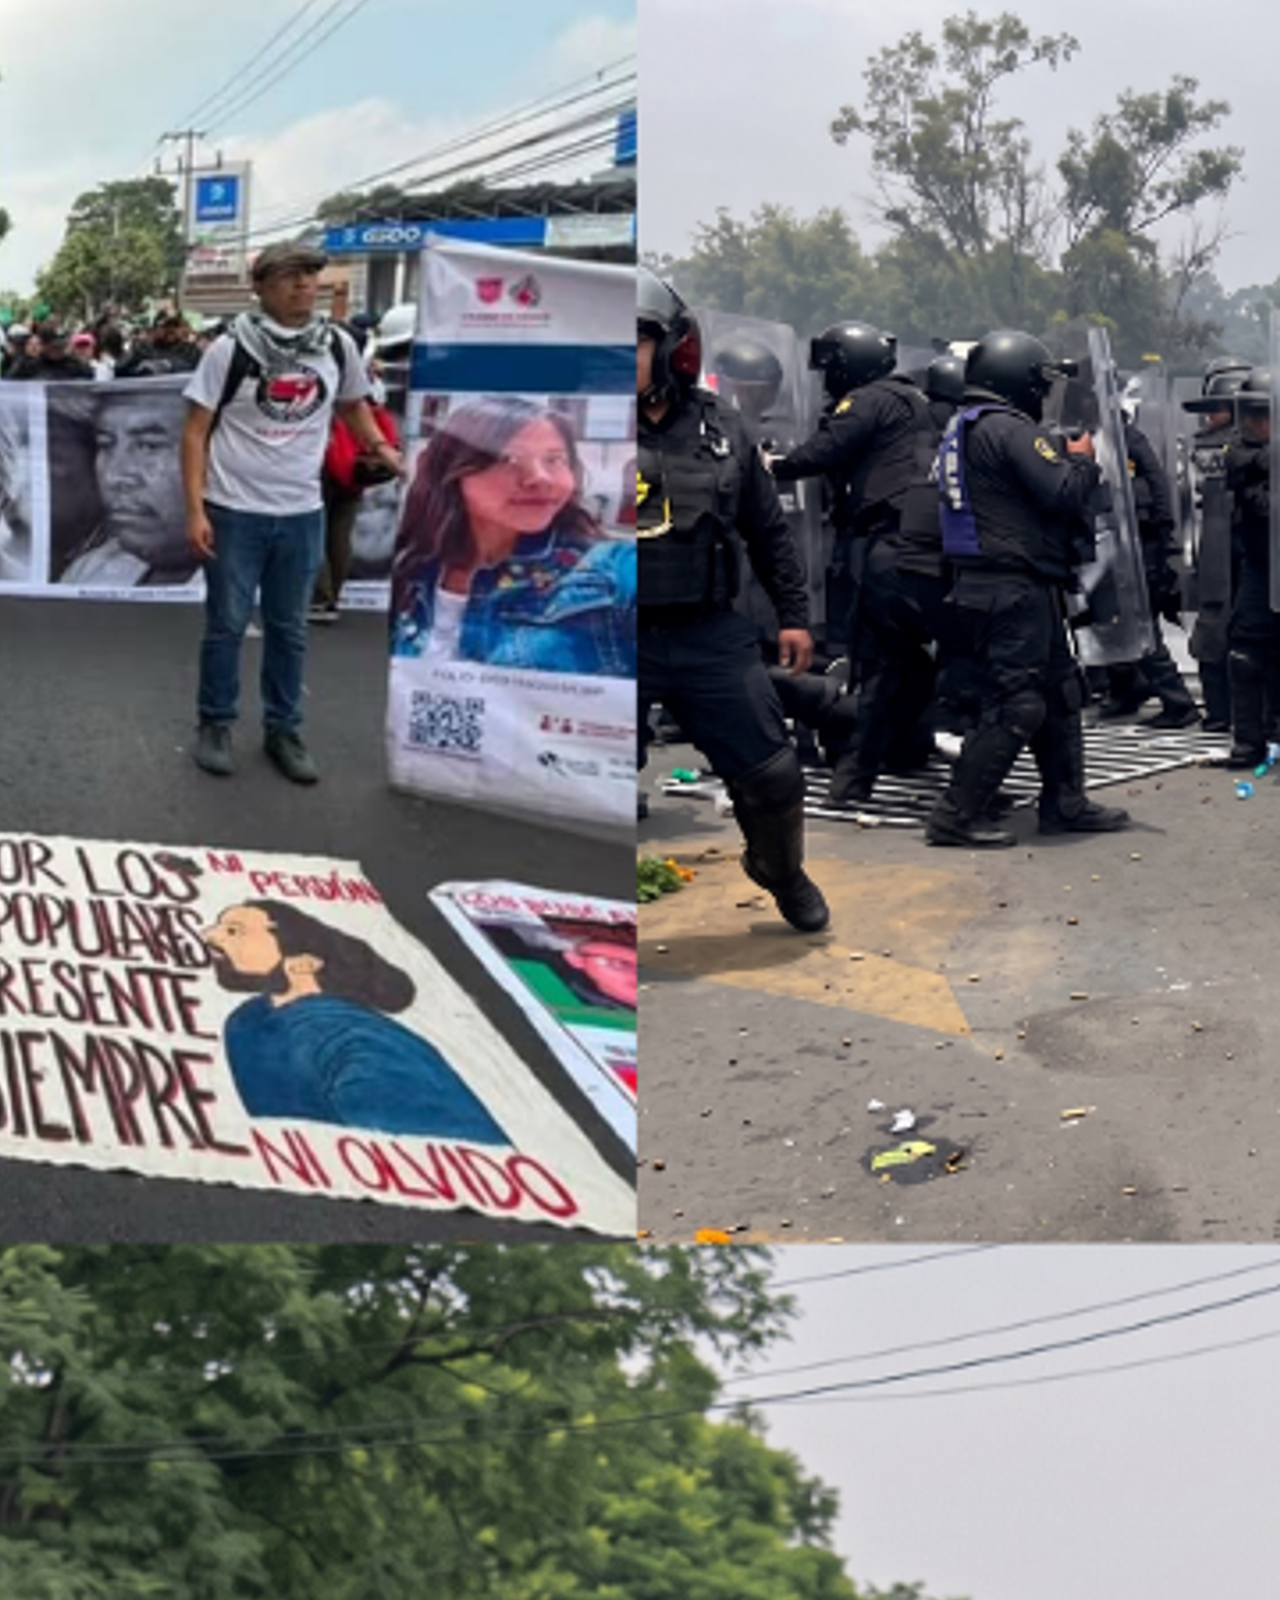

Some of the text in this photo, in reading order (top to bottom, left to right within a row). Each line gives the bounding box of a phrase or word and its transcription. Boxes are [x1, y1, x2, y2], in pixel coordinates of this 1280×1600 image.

[75, 846, 202, 903] LOS
[250, 1127, 578, 1218] NI OLVIDO
